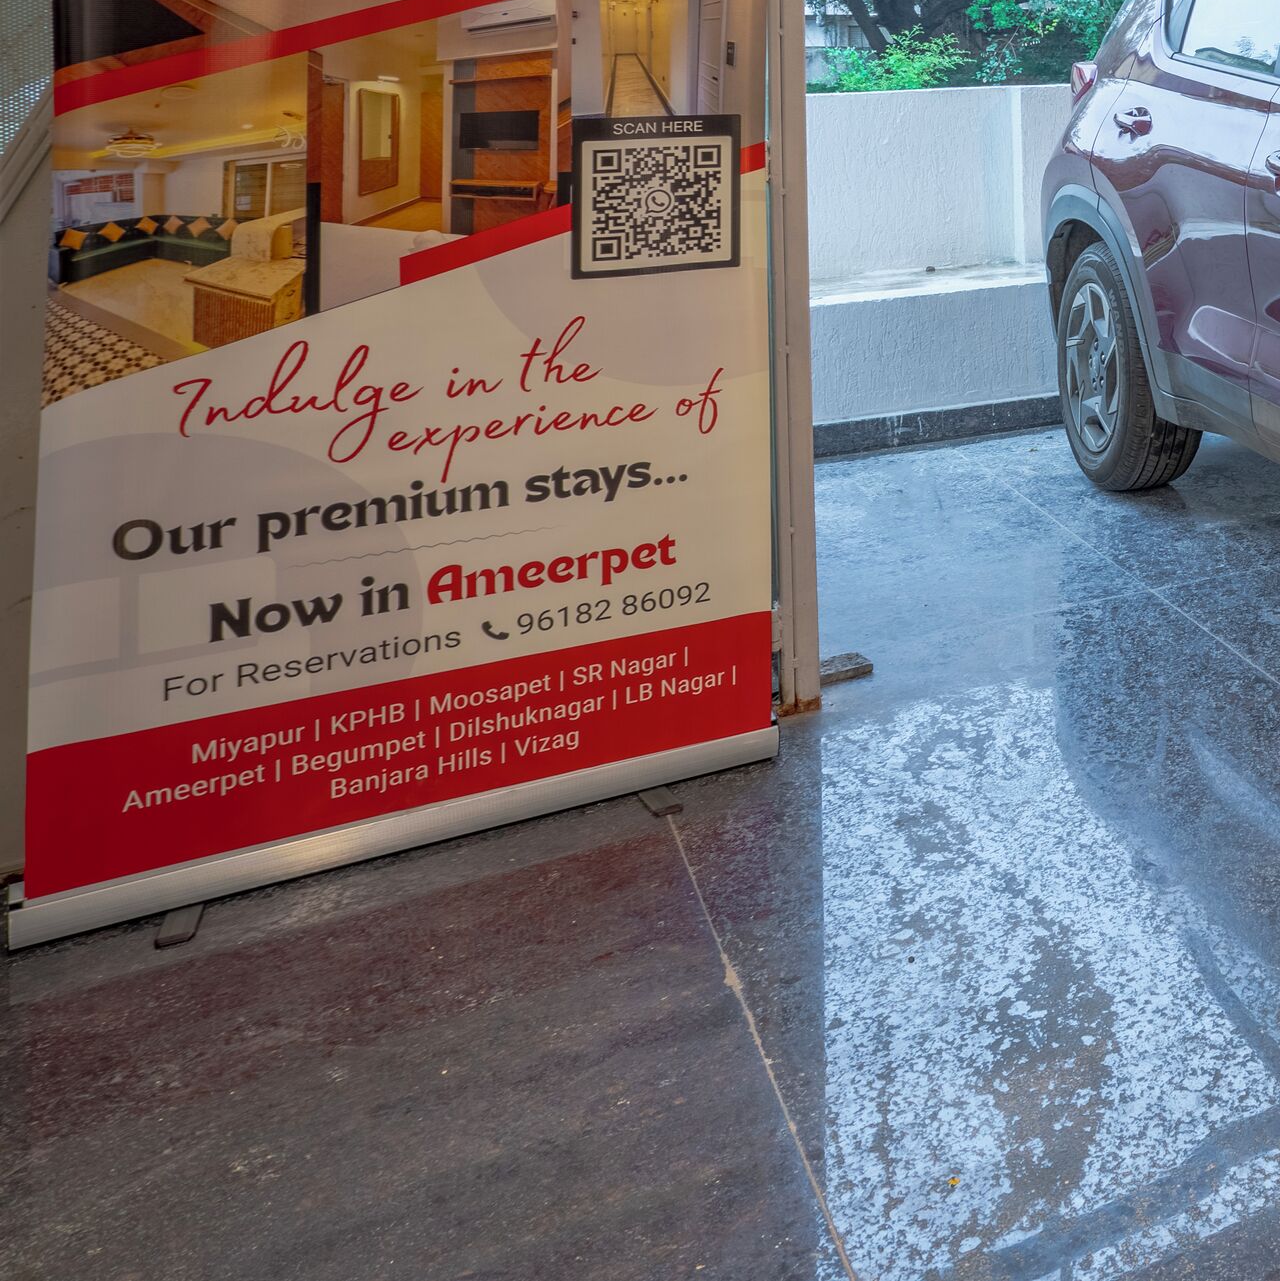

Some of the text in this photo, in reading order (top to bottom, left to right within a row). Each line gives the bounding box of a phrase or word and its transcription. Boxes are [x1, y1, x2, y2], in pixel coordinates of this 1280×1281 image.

[613, 120, 703, 135] SCAN HERE
[172, 316, 602, 464] Indulge in the
[387, 368, 724, 483] experience of
[111, 462, 687, 561] Our premium stays...
[163, 582, 710, 701] For Reservations 96182 86092
[209, 535, 678, 643] Now in Ameerpet
[121, 764, 266, 812] Ameerpet
[292, 731, 426, 775] Begumpet
[450, 696, 605, 742] Dilshuknagar
[626, 682, 653, 705] LB
[661, 671, 725, 697] Nagar
[192, 726, 305, 764] Miyapur
[331, 703, 405, 735] KPHB
[430, 674, 551, 715] Moosapet
[573, 663, 603, 685] SR
[611, 652, 677, 678] Nagar
[331, 764, 428, 799] Banjara
[439, 747, 492, 775] Hills
[514, 731, 579, 756] Vizag
